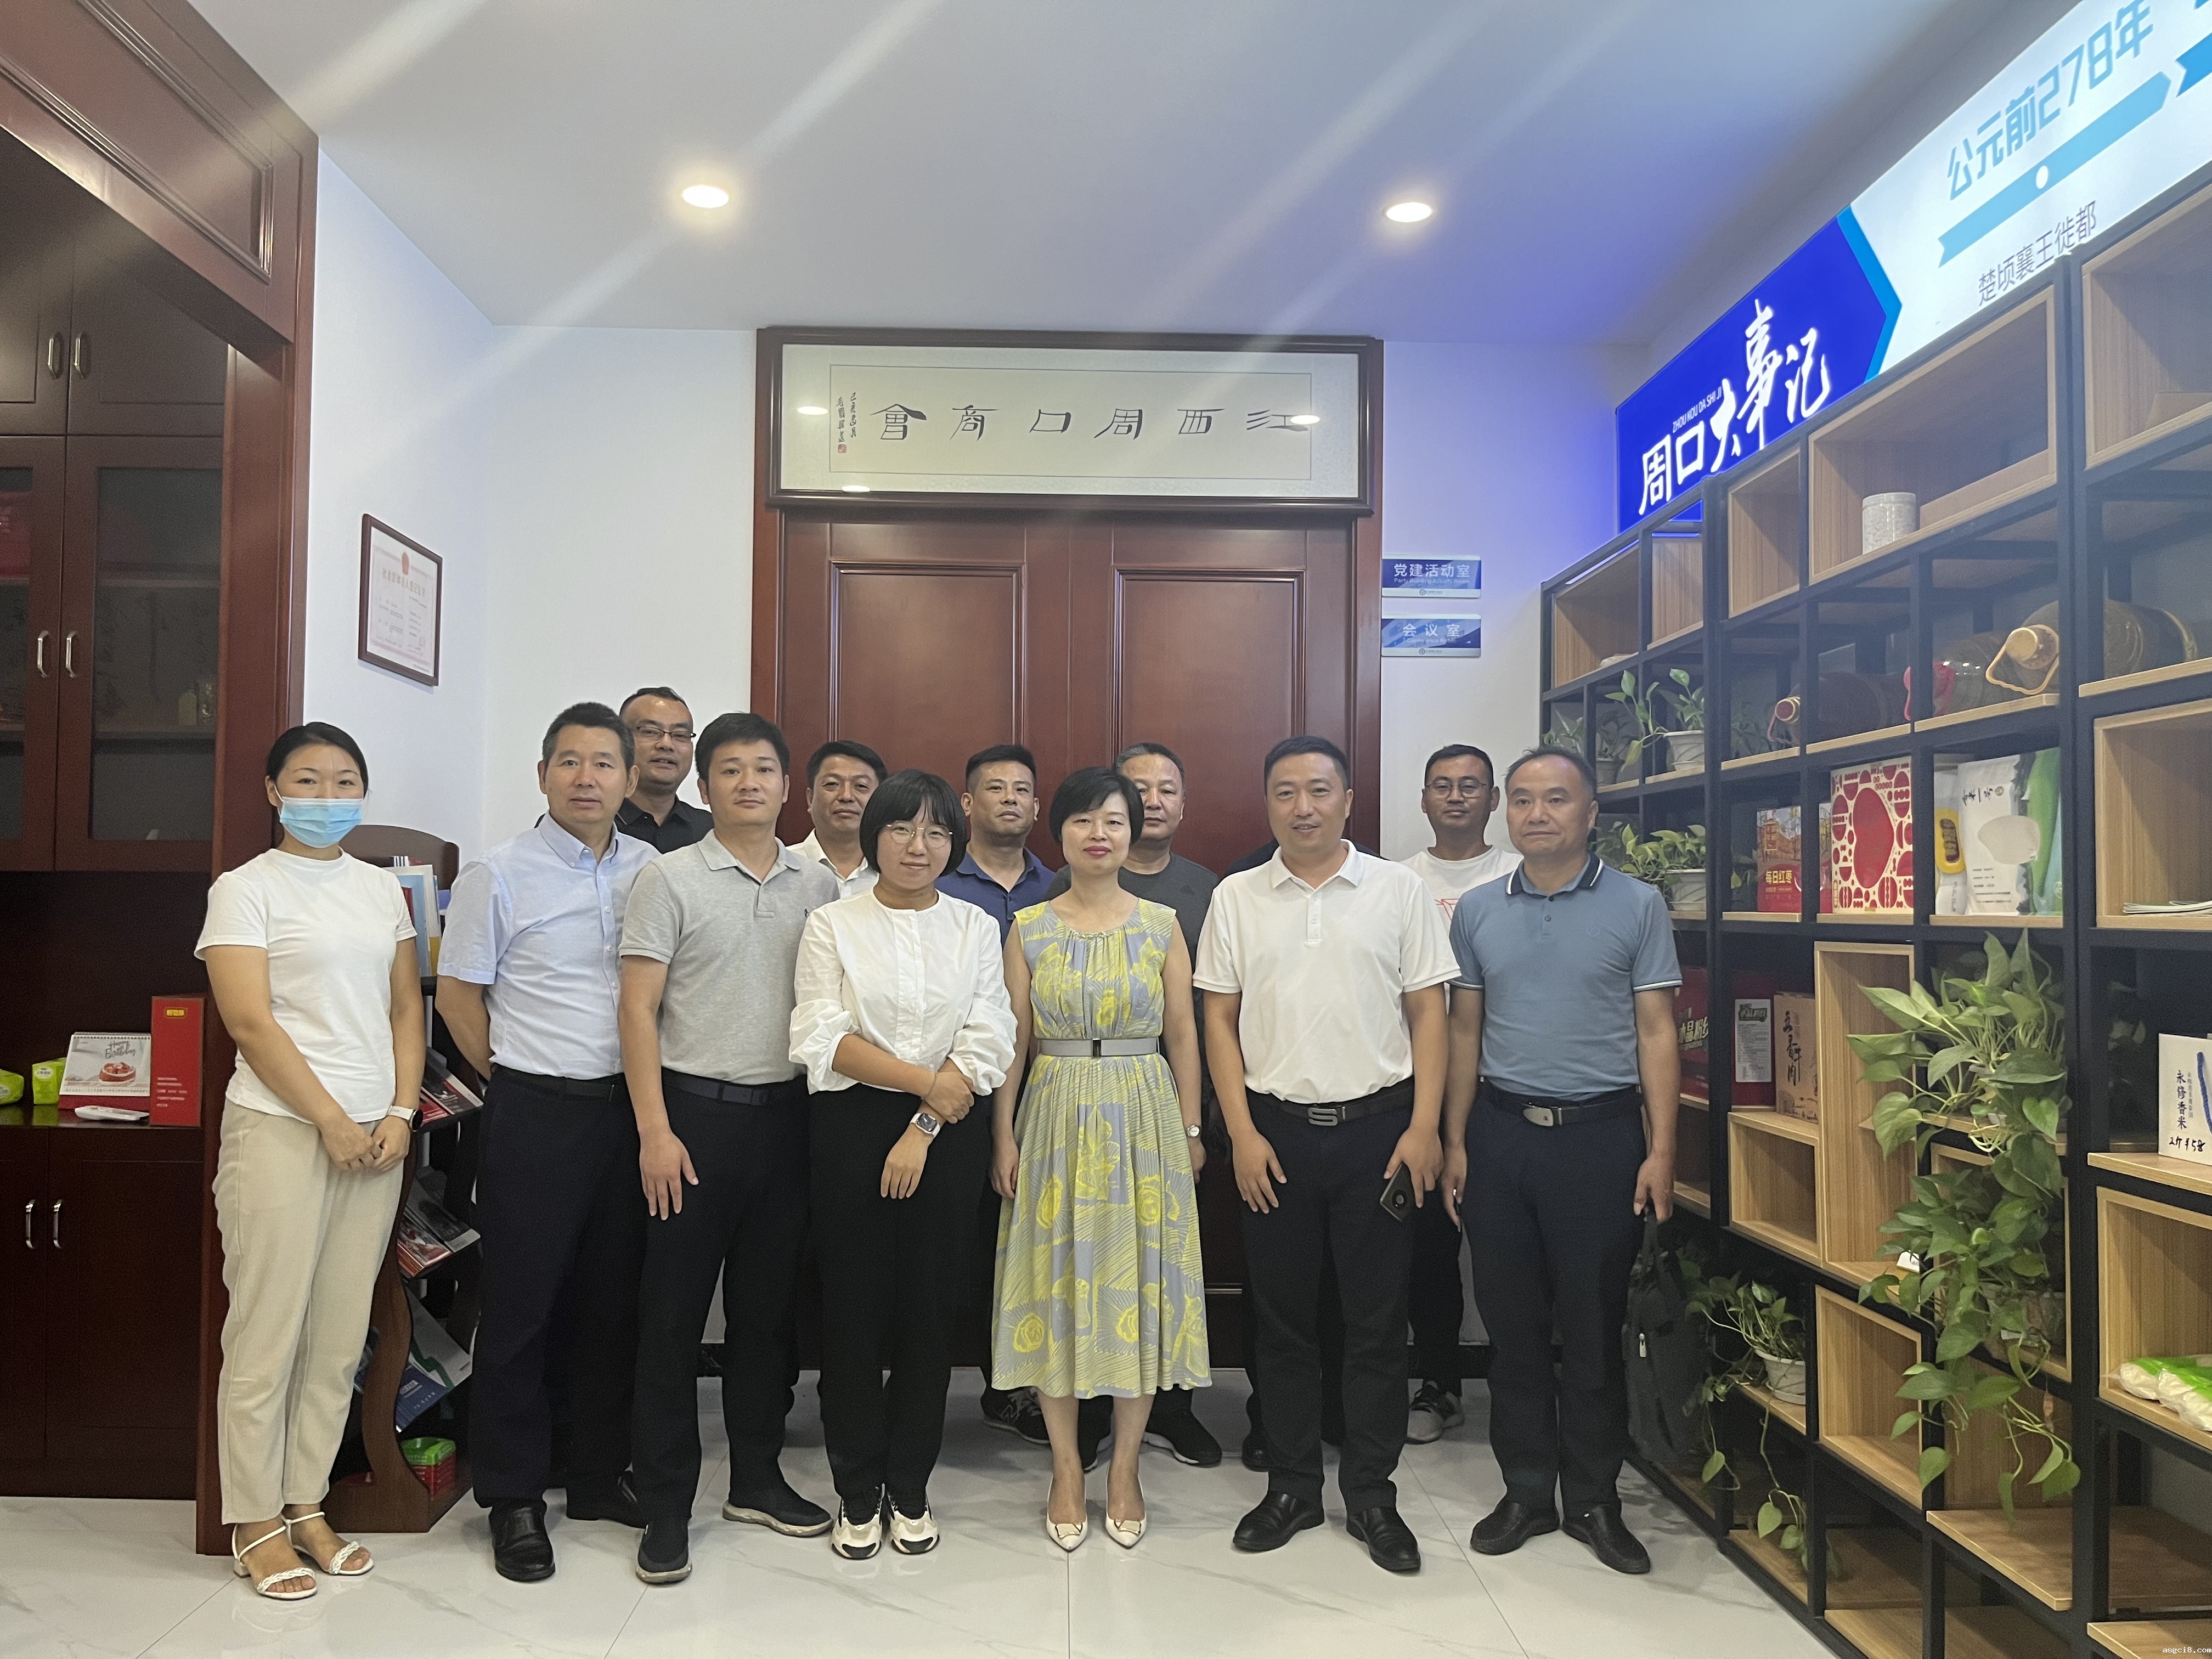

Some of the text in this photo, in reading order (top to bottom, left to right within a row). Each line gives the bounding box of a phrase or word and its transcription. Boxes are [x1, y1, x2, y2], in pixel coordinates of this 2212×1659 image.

[1947, 0, 2154, 201] 公元前278年
[1978, 200, 2097, 307] 楚顷襄王徙都
[1638, 298, 1831, 516] 周口大事记
[1672, 386, 1722, 433] ZHOU KOU DA SHI JI
[1393, 563, 1471, 578] 党建活动室
[1402, 623, 1460, 637] 会议室
[2176, 1069, 2187, 1130] 永修香米
